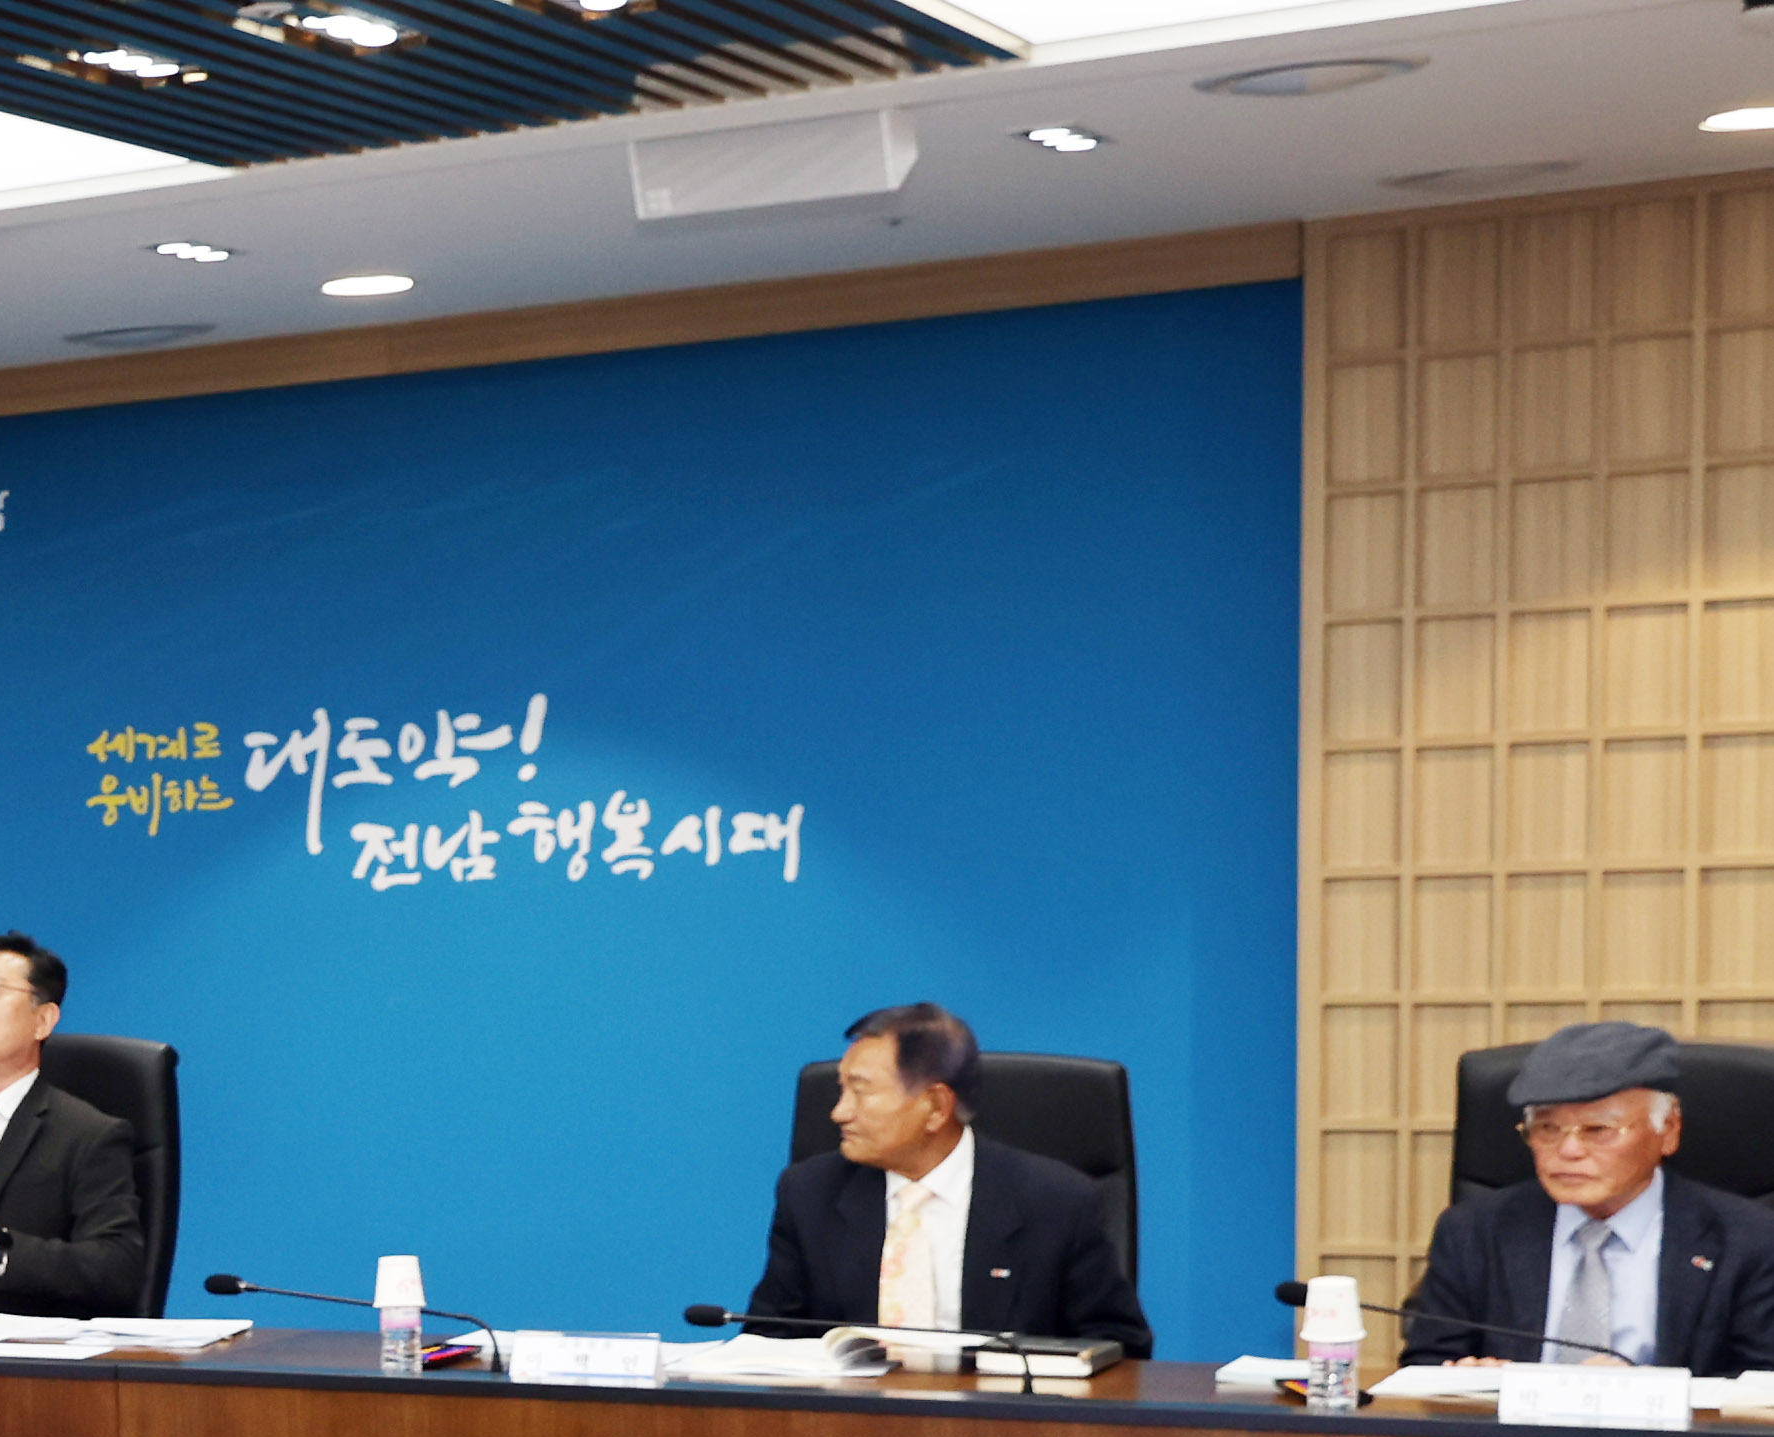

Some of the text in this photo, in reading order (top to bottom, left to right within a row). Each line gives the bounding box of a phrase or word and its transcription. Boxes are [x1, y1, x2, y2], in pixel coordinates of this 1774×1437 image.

[86, 722, 223, 769] 세계로
[243, 693, 549, 856] 대도약!
[86, 773, 234, 837] 웅비하는
